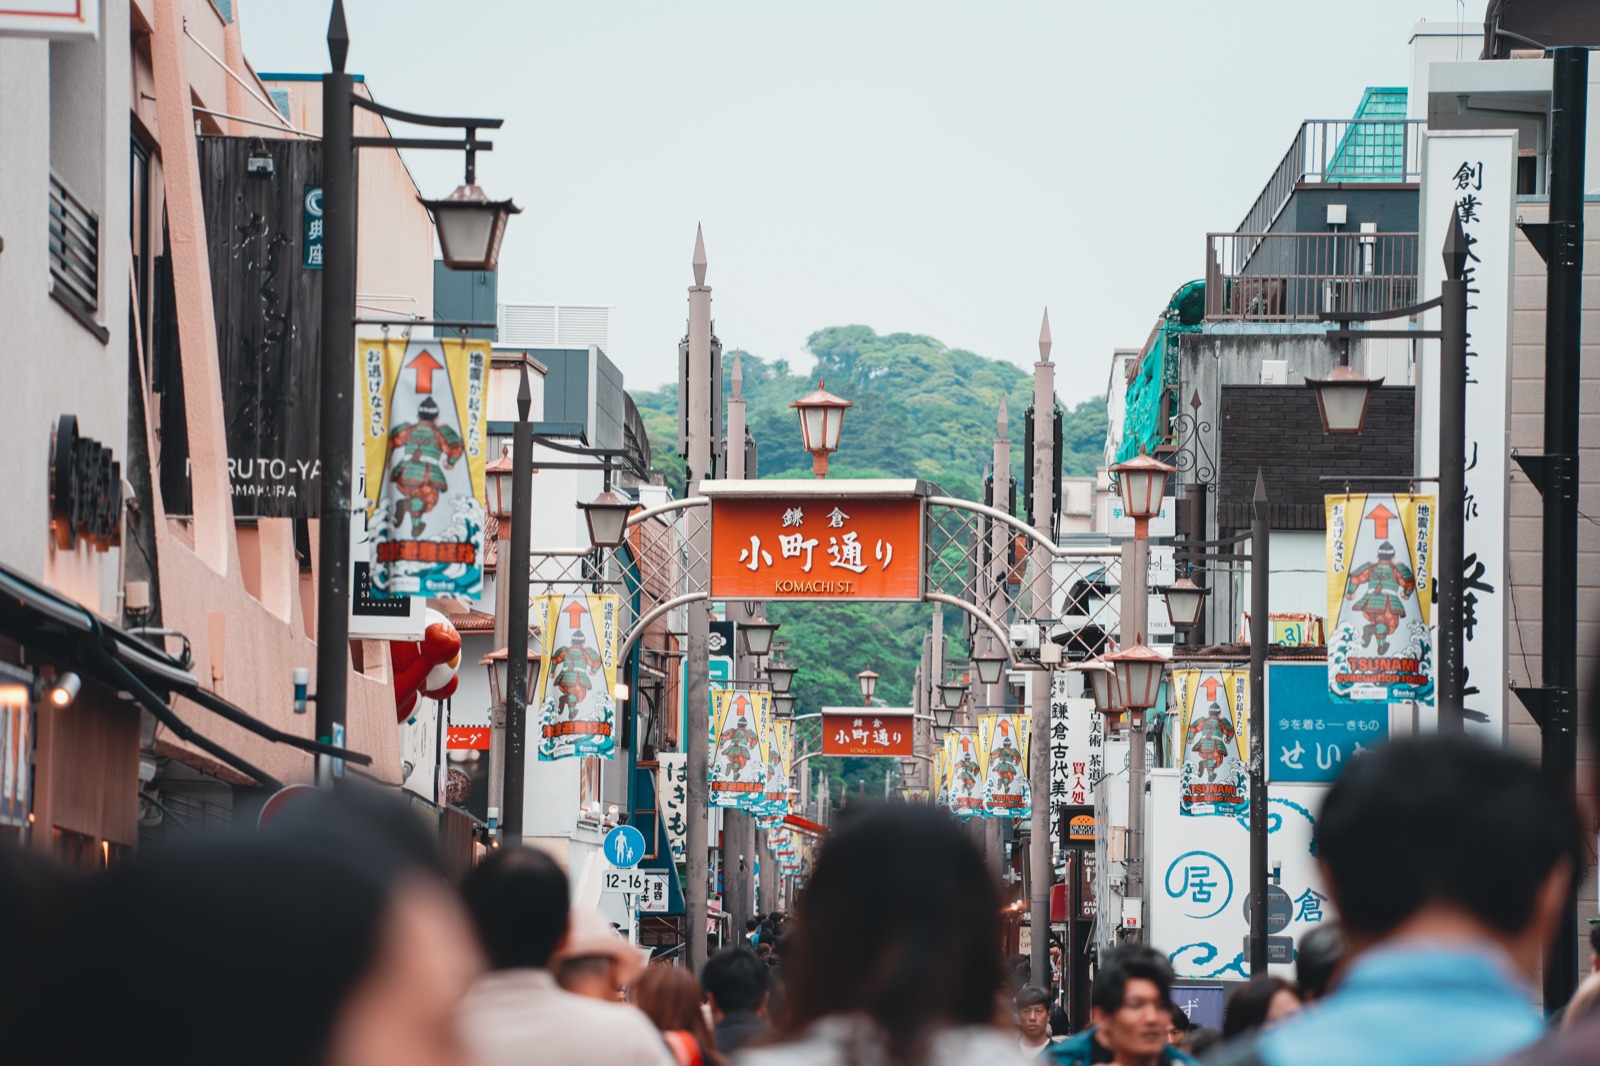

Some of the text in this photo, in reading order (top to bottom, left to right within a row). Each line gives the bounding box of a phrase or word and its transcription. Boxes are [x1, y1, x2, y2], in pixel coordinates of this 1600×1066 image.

[366, 350, 386, 437] お逃げなさい
[468, 351, 485, 457] 地震が起きたら
[739, 531, 894, 574] 小町通り
[1332, 504, 1346, 573] お逃げなさい
[1416, 504, 1430, 590] 地震が起きたら
[775, 581, 855, 593] KOMACHI ST.
[604, 602, 614, 668] 地震が起きたら
[1336, 673, 1400, 683] evacuation
[1348, 657, 1419, 672] TSUNAMI
[1235, 675, 1245, 737] 地震が起きたら
[835, 728, 902, 746] 小町通り
[1072, 762, 1086, 805] 買入処
[1189, 784, 1237, 795] TSUNAMI
[606, 874, 642, 889] 12-16
[653, 881, 663, 901] 理容
